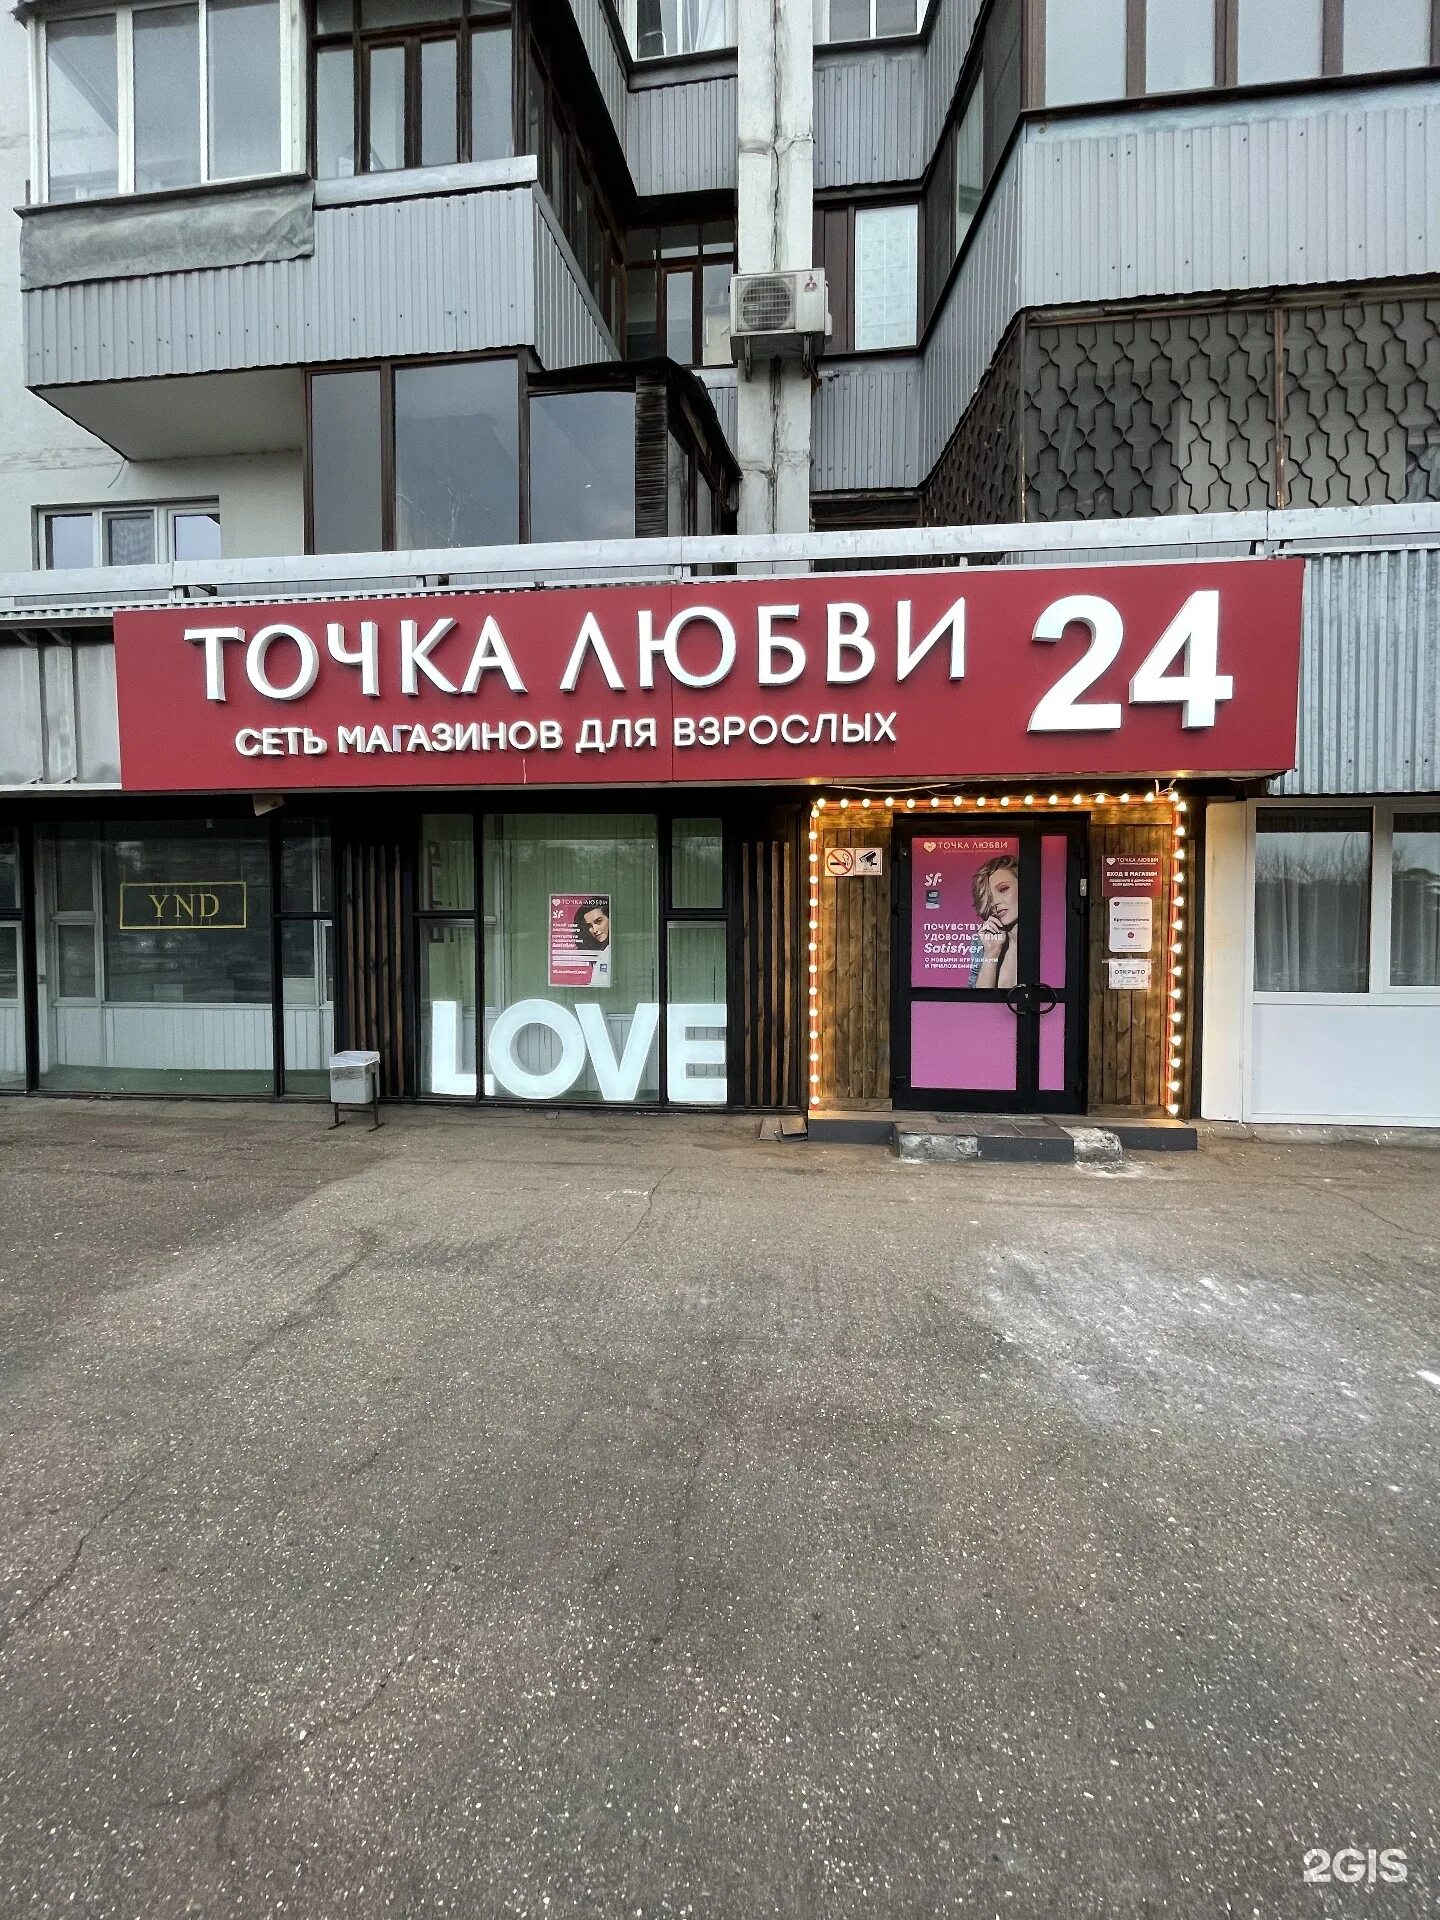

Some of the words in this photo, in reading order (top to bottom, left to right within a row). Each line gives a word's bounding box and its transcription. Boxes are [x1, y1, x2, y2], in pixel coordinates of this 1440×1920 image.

[184, 615, 528, 701] ТОЧКА
[560, 597, 966, 692] ЛЮБВИ
[1027, 590, 1234, 734] 24
[234, 726, 327, 757] СЕТЬ
[337, 720, 563, 754] МАГАЗИНОВ
[575, 718, 657, 753] ДЛЯ
[674, 711, 897, 748] ВЗРОСЛЫХ
[972, 841, 1008, 849] ЛЮБВИ
[149, 893, 220, 918] YND
[923, 942, 984, 956] Satisfyer
[924, 933, 1004, 941] УДОВОЛЬСТВИЕ
[431, 998, 728, 1104] LOVE
